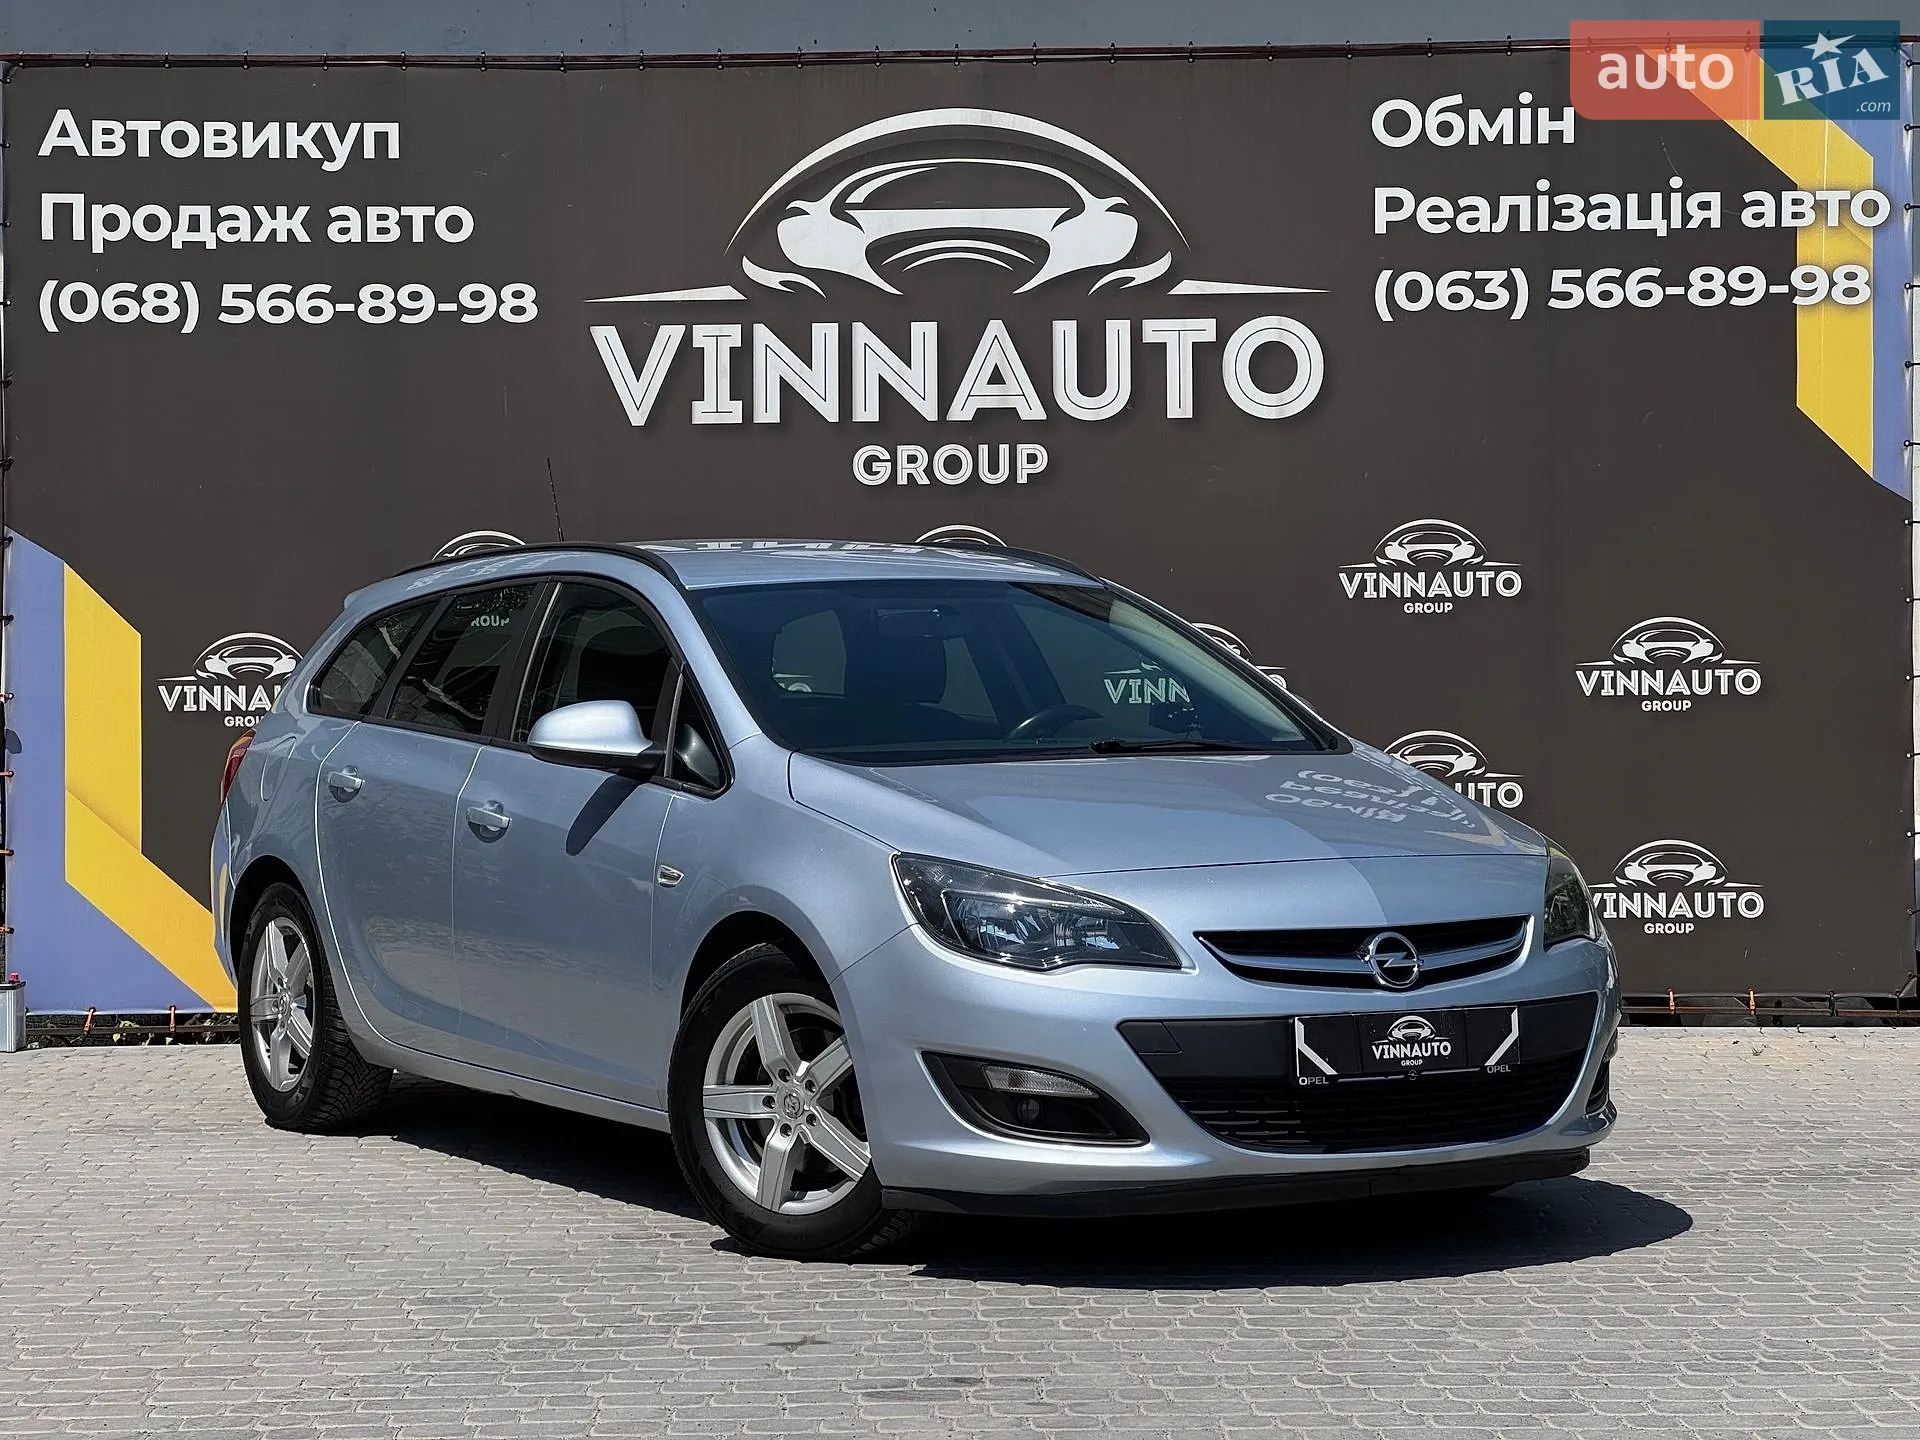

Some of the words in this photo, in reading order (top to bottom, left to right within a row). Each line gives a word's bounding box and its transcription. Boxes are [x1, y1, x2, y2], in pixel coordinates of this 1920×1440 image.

[1371, 91, 1576, 148] Обмін
[37, 109, 400, 172] Автовикуп
[1374, 176, 1722, 237] Реалізація
[1740, 189, 1891, 229] авто
[41, 193, 312, 254] Продаж
[327, 204, 475, 243] авто
[39, 280, 199, 333] (068)
[217, 282, 538, 324] 566-89-98
[1374, 268, 1529, 322] (063)
[1547, 264, 1871, 309] 566-89-98
[589, 315, 1325, 427] VINNAUTO
[852, 443, 1048, 486] GROUP
[1338, 570, 1522, 599] VINNAUTO
[1403, 602, 1453, 615] GROUP
[1575, 668, 1762, 698] VINNAUTO
[158, 685, 281, 712] VINNA
[1641, 699, 1692, 712] GROUP
[1644, 923, 1695, 934] GROUP
[1371, 1041, 1452, 1060] VINNAUTO
[1400, 1059, 1423, 1067] GROUP
[1298, 1076, 1329, 1086] OPEL
[1486, 1064, 1511, 1074] OPEL
